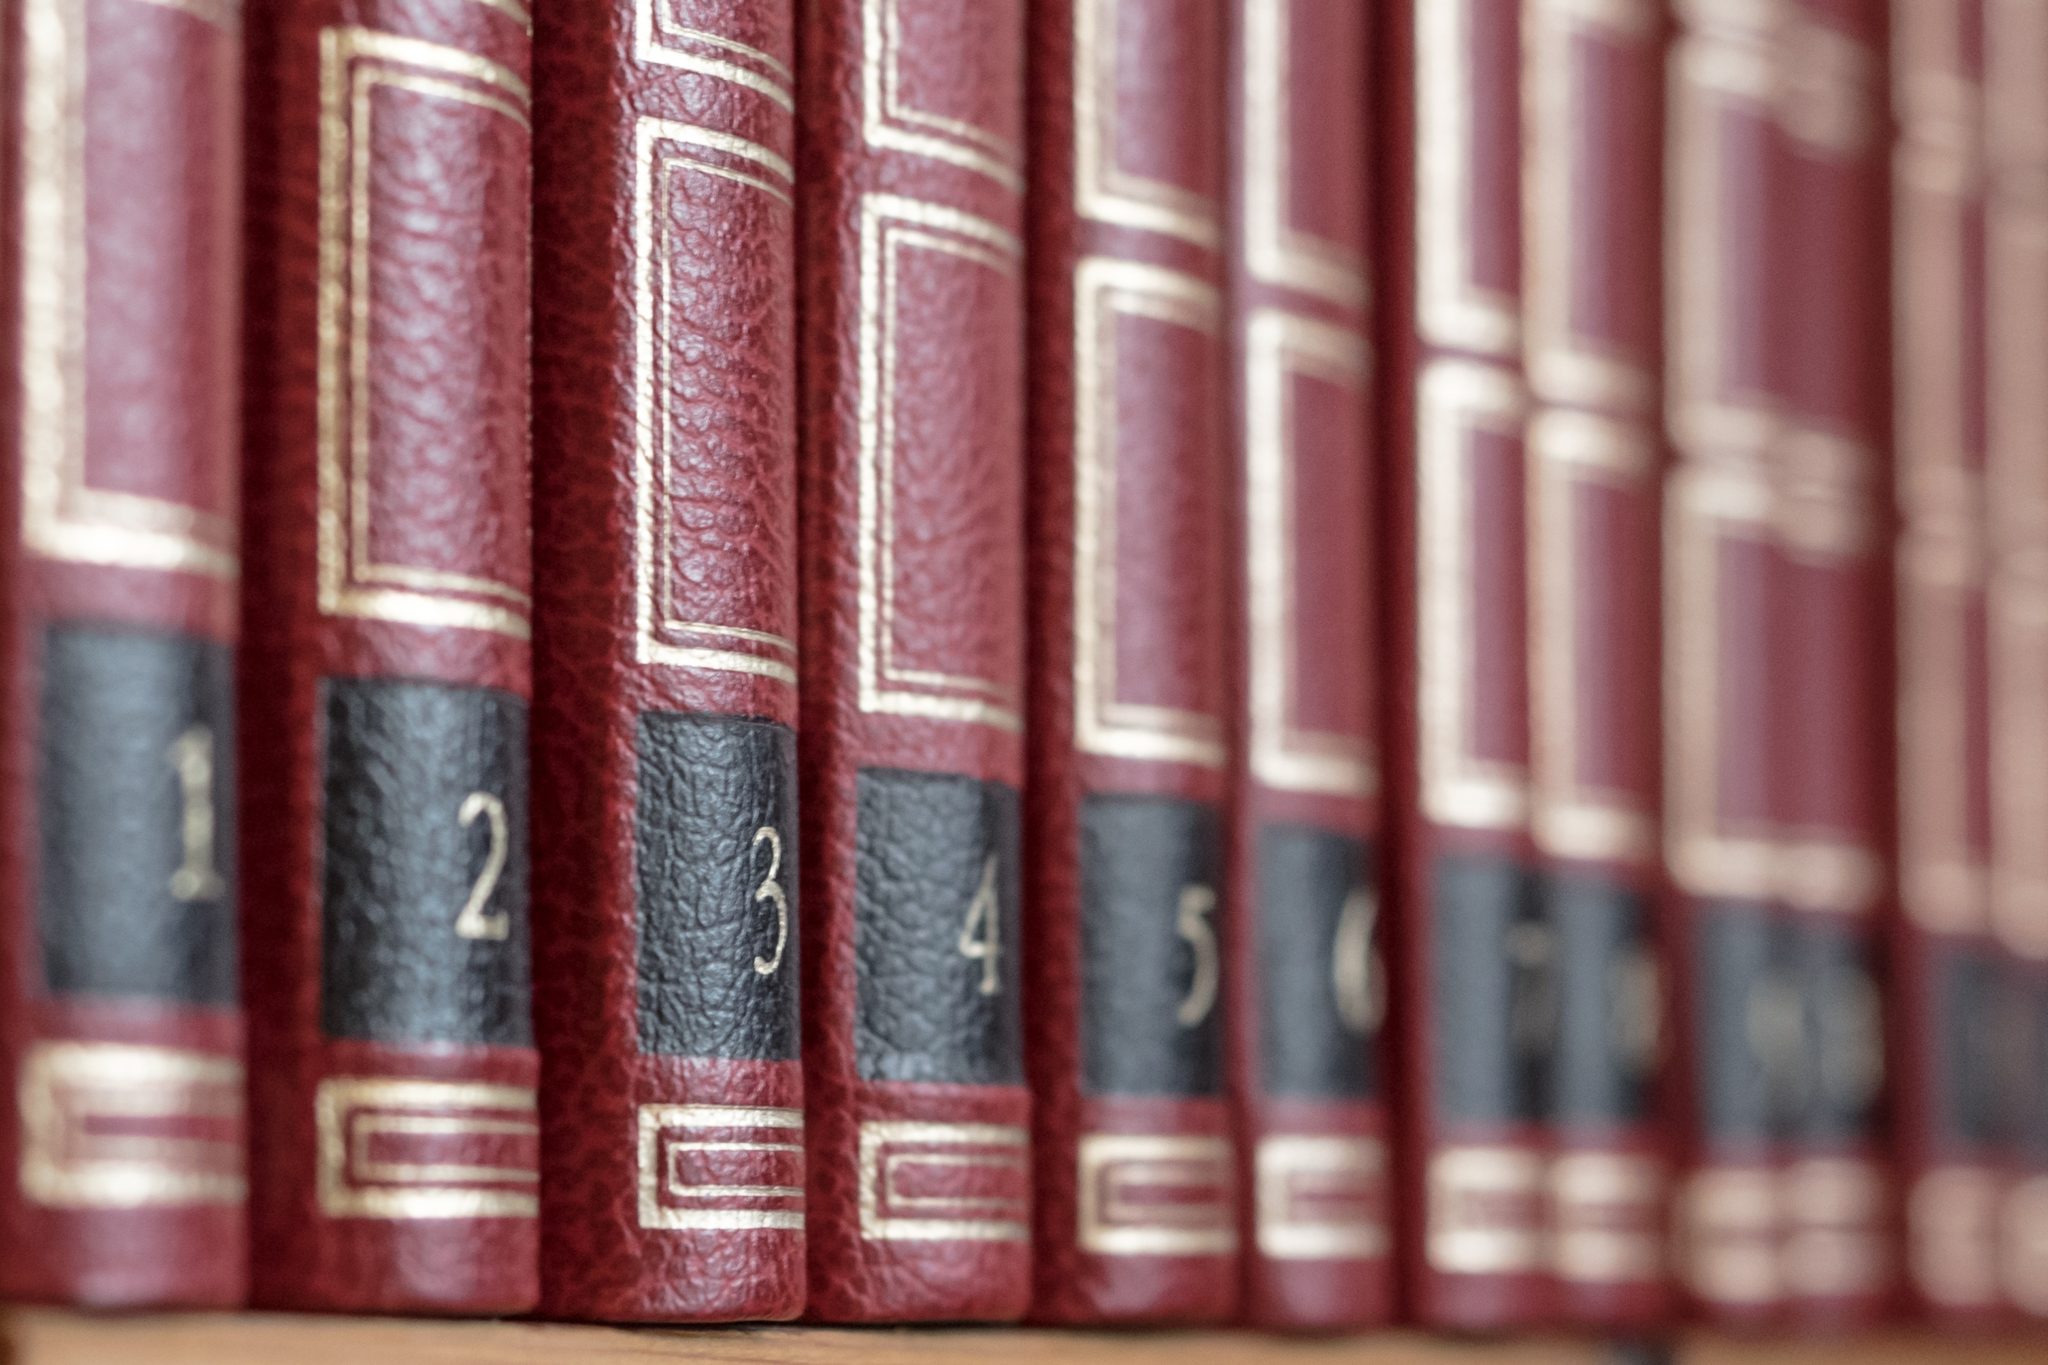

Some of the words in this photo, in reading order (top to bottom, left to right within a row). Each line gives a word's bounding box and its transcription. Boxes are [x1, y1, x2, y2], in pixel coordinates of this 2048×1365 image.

[169, 728, 226, 900] 1
[455, 791, 509, 941] 2
[753, 826, 788, 974] 3
[959, 853, 999, 995] 4
[1177, 884, 1219, 1028] 5
[1332, 889, 1388, 1035] 6
